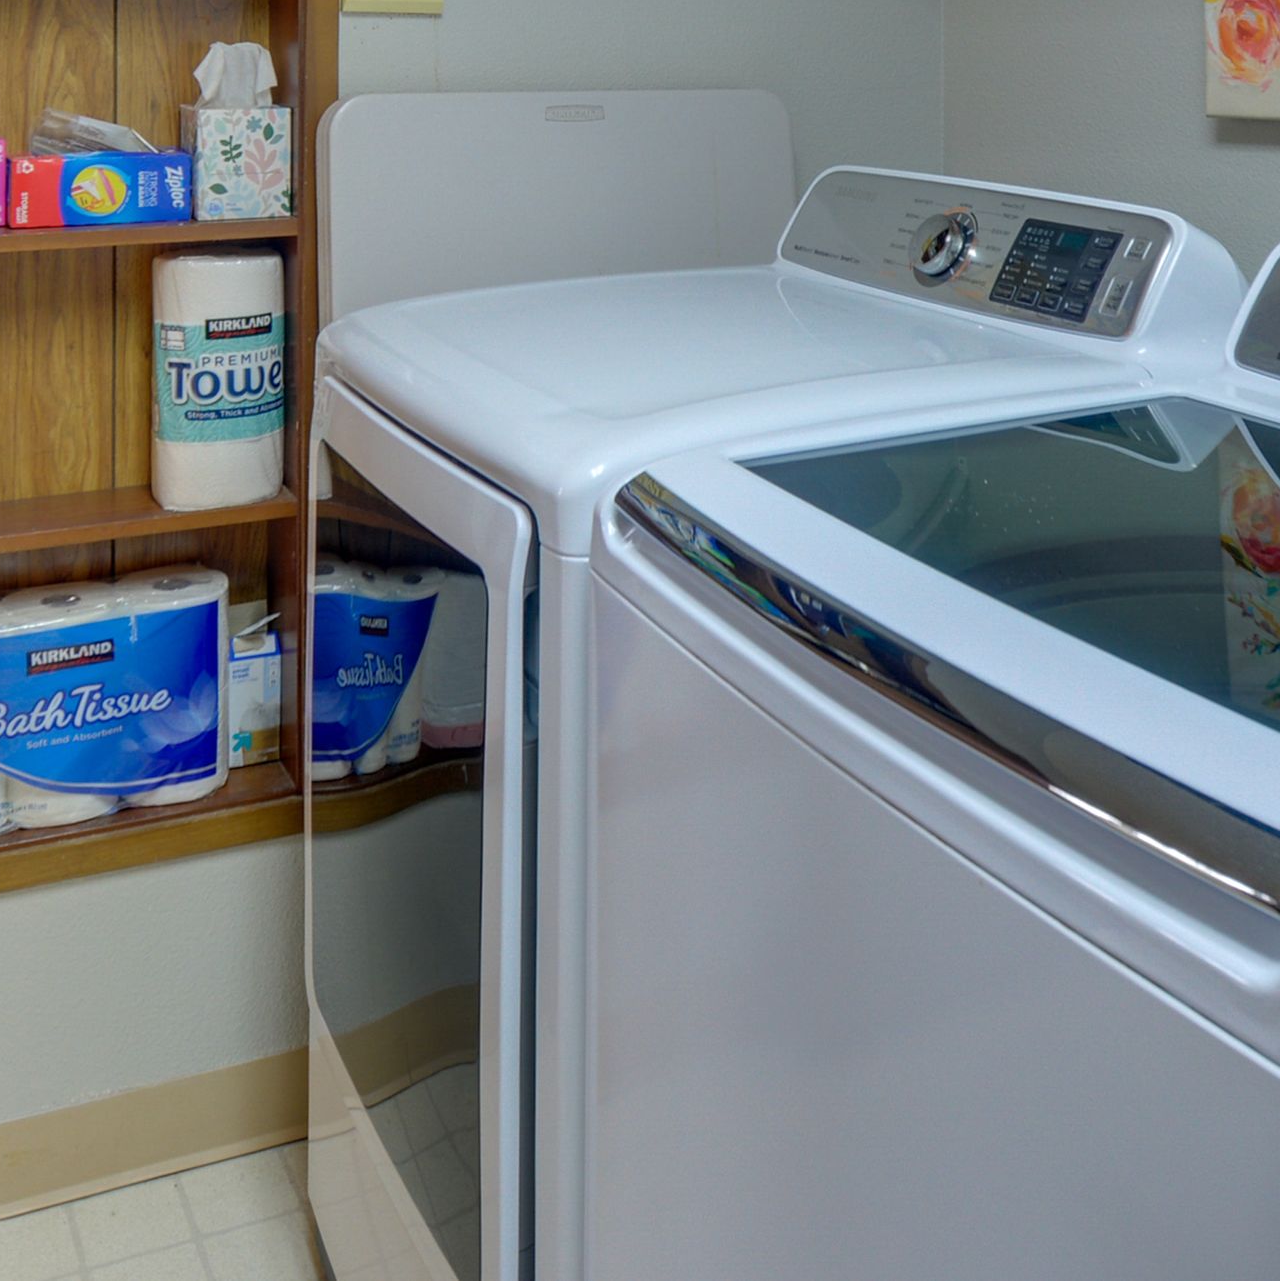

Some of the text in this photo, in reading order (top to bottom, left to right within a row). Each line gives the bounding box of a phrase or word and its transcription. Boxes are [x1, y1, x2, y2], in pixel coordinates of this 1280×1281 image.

[149, 171, 158, 207] STRONG
[165, 166, 185, 208] Ziploc
[20, 192, 28, 223] STORAGE
[208, 315, 271, 332] KIRKLAND
[202, 347, 278, 367] PREMIUM
[168, 360, 282, 400] Towe
[187, 409, 217, 419] Strong,
[221, 409, 241, 417] Thick
[245, 407, 258, 415] and
[31, 642, 112, 666] KIRKLAND
[70, 684, 171, 728] Tissue
[27, 725, 123, 750] Soft and Absorbent
